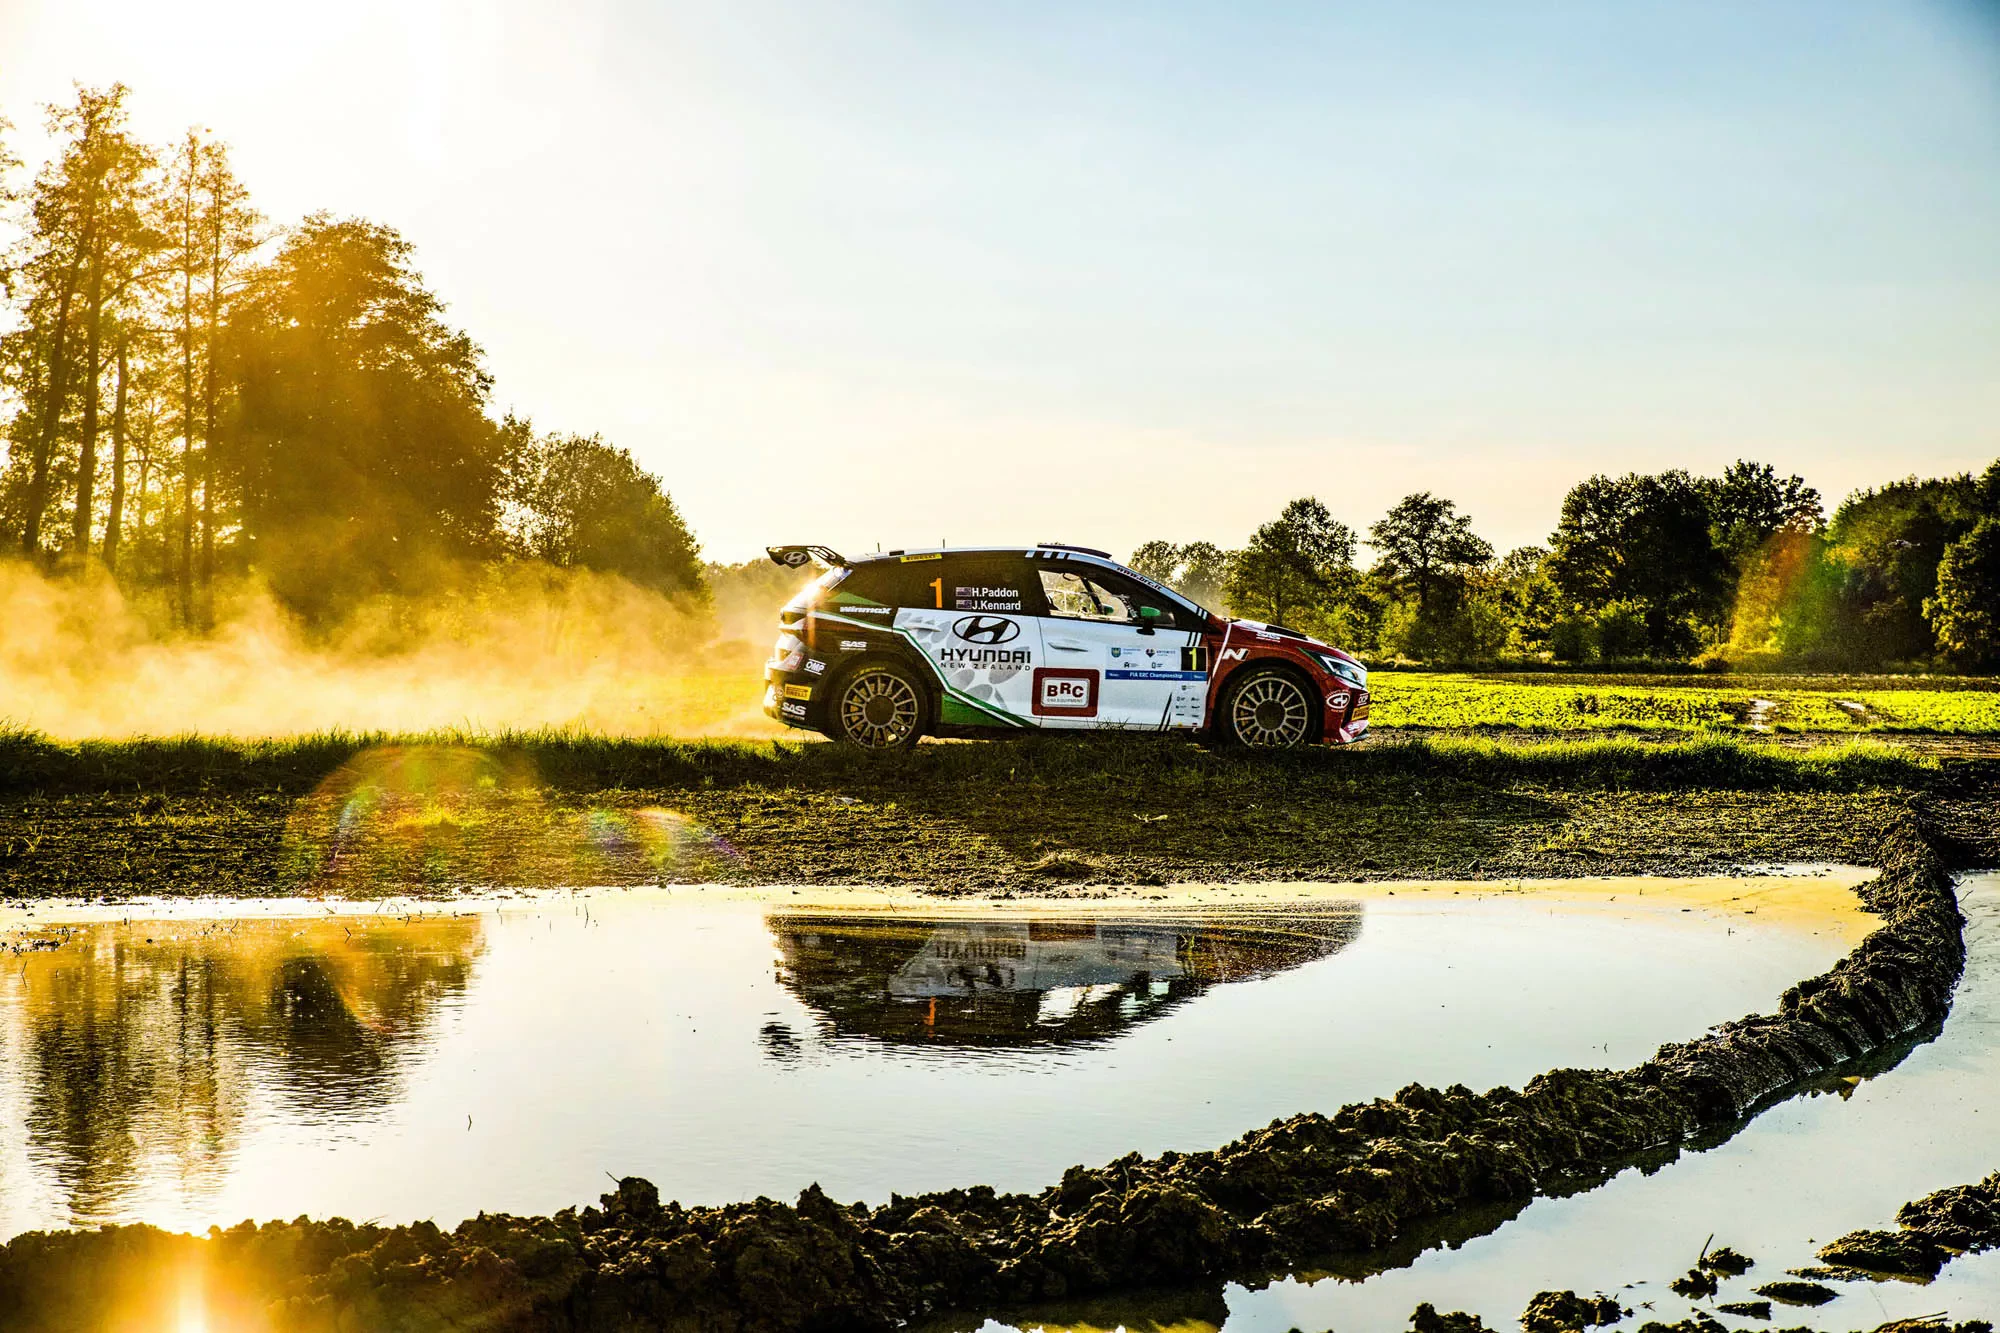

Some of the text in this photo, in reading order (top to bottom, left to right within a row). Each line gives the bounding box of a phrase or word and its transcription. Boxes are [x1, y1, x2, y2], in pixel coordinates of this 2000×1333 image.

[1116, 566, 1162, 590] www.brc.it
[929, 577, 942, 608] 1
[971, 588, 1019, 598] H.Paddon
[972, 600, 1021, 611] J.Kennard
[841, 640, 867, 648] SAS
[941, 648, 1031, 663] HYUNDAI
[1189, 647, 1197, 671] 1
[806, 660, 825, 672] OMP
[974, 663, 1031, 671] ZEALAND
[1150, 672, 1183, 680] Championship
[1047, 682, 1084, 698] BRC
[782, 702, 807, 716] SAS
